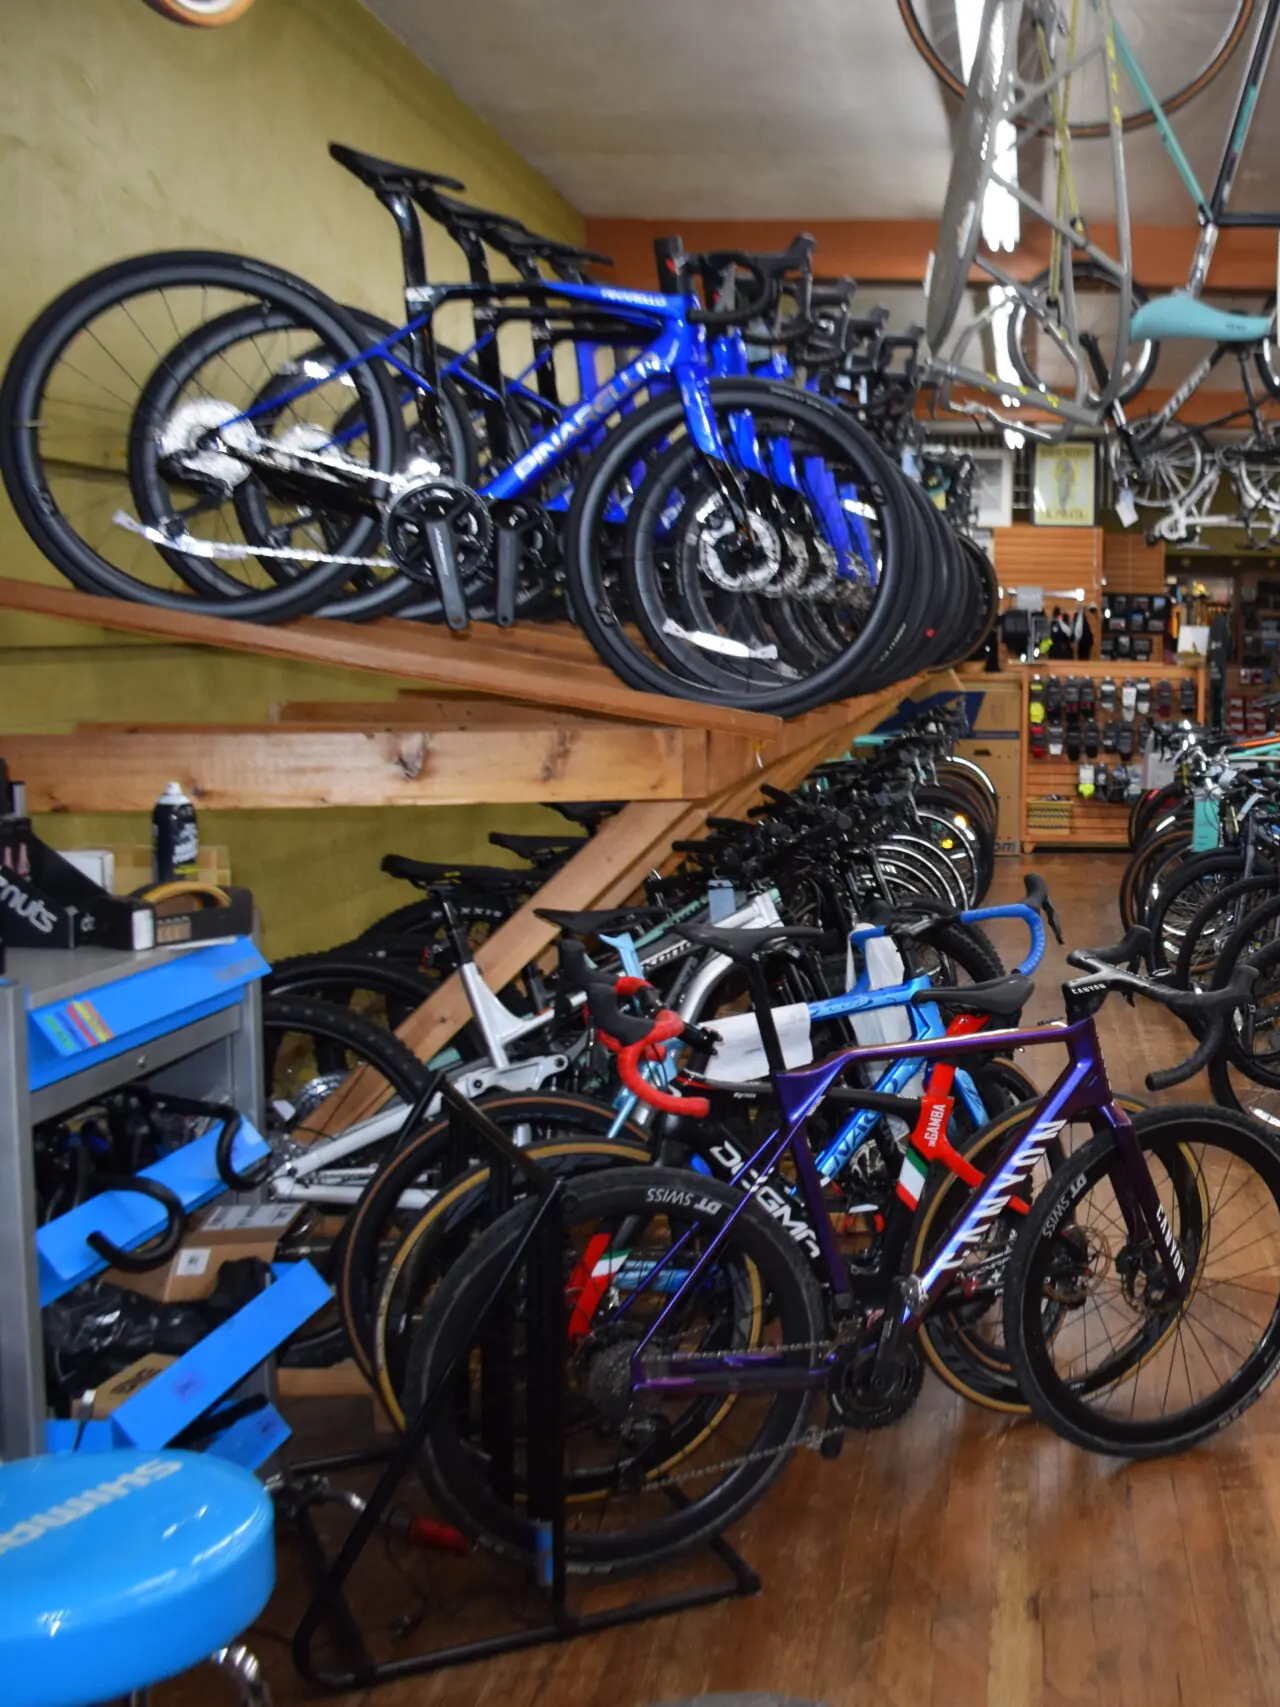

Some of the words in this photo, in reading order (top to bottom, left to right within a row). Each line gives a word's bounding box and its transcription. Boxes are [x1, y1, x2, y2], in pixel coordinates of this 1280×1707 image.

[1070, 983, 1108, 996] CANYON
[646, 1187, 695, 1203] SWISS
[1069, 1173, 1088, 1200] DT
[693, 1200, 723, 1216] DT
[1042, 1199, 1071, 1239] SWISS
[1156, 1202, 1187, 1284] CANYON
